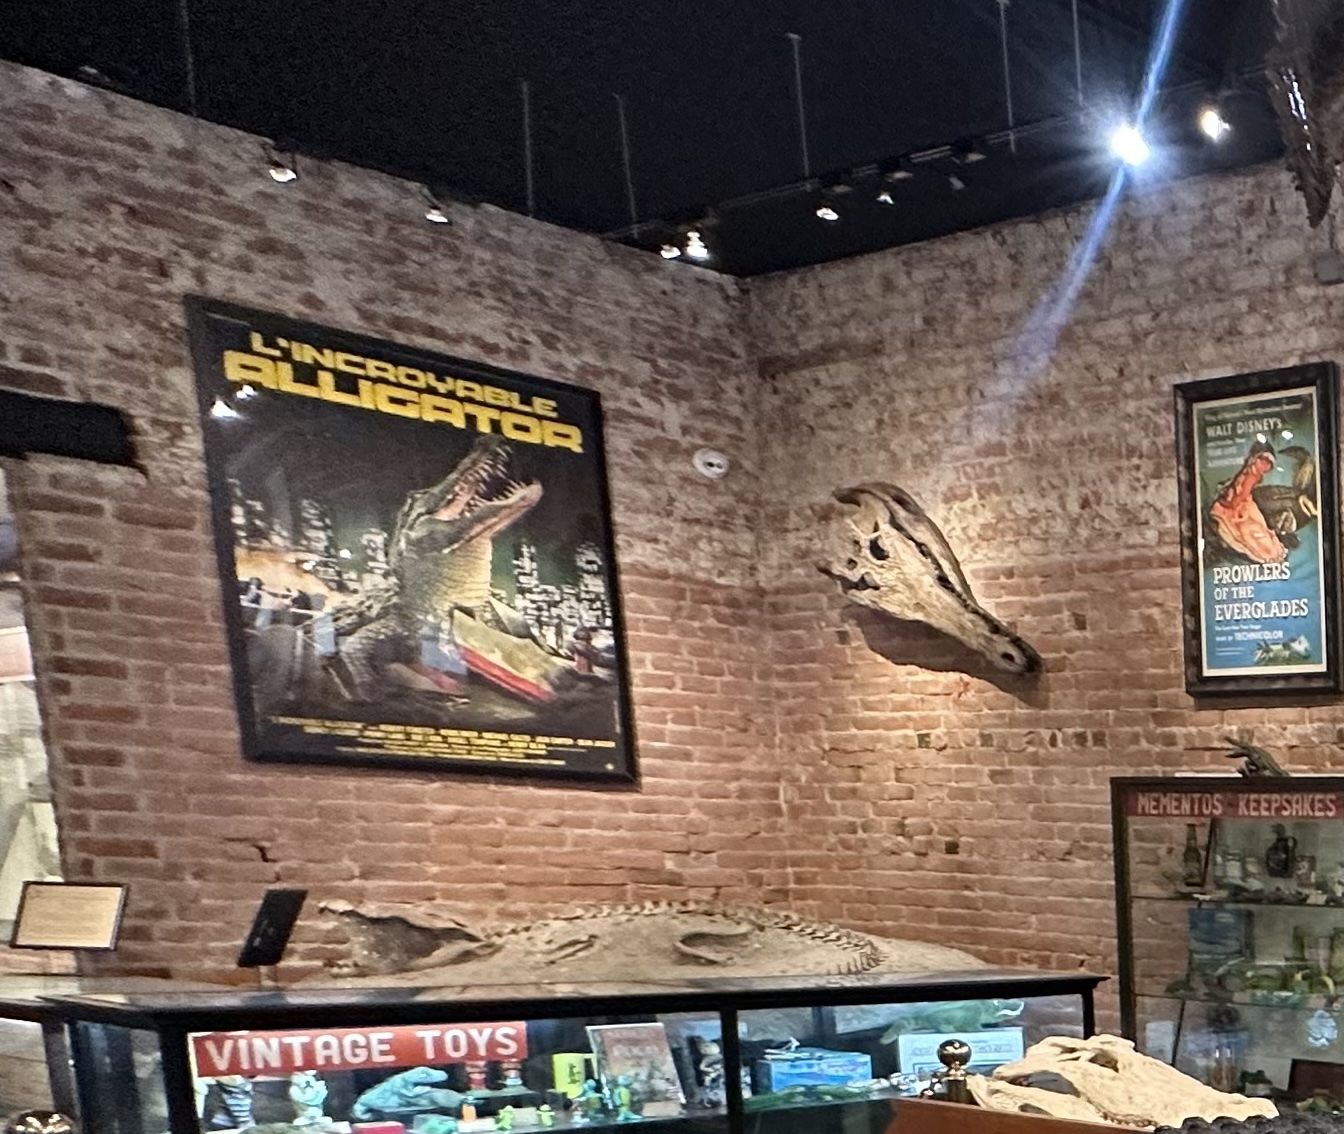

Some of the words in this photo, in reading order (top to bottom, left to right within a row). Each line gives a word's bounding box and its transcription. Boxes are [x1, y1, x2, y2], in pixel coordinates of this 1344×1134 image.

[250, 331, 559, 418] L'INCROYABLE
[223, 349, 584, 454] ALLIGATOR
[1206, 422, 1233, 438] WALT
[1212, 561, 1292, 585] PROWLERS
[1213, 587, 1229, 601] OF
[1231, 586, 1255, 599] THE
[1214, 598, 1309, 621] EVERGLADES
[1137, 793, 1224, 816] MEMENTOS
[1237, 792, 1338, 819] KEEPSAKES
[204, 1030, 396, 1074] VINTAGE
[415, 1026, 521, 1059] TOYS
